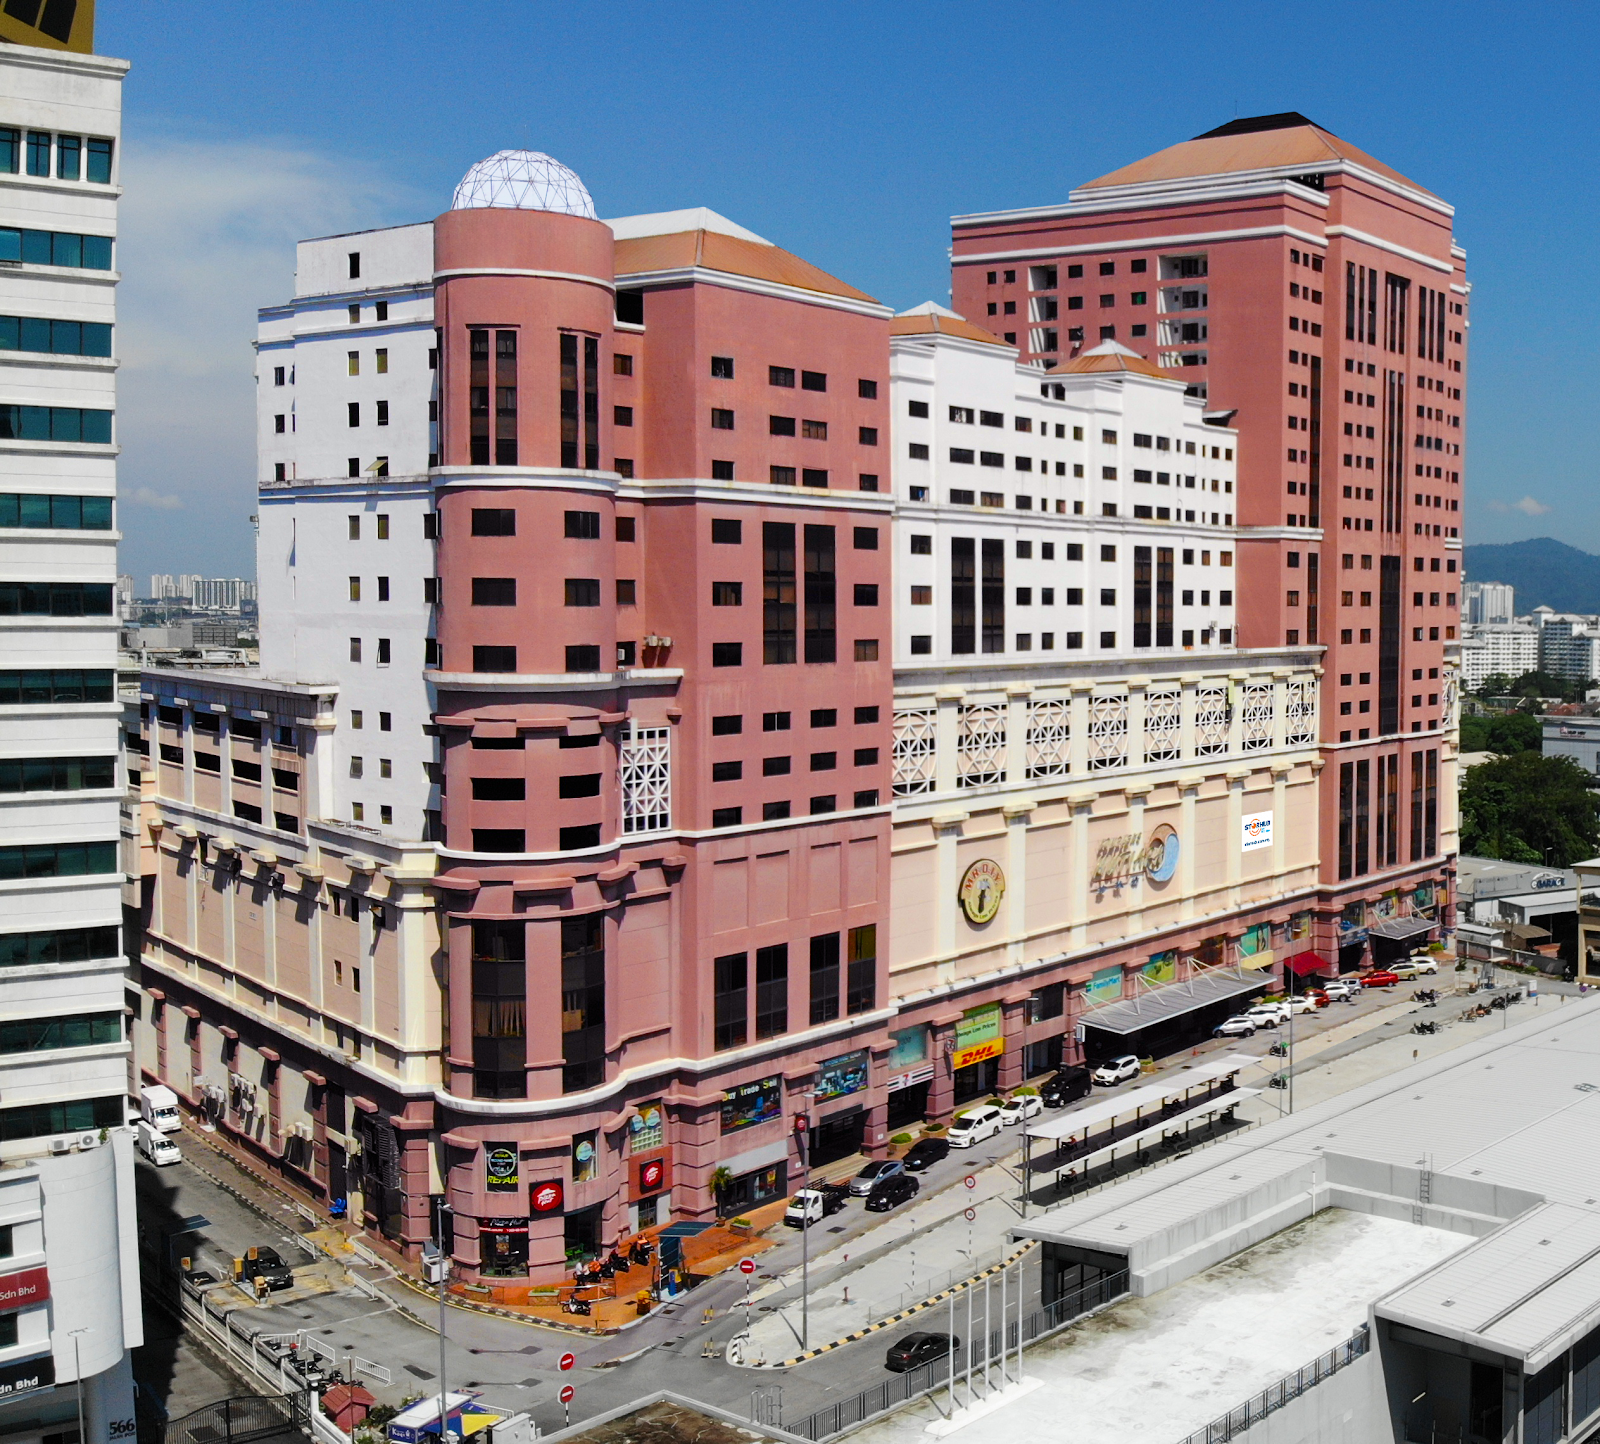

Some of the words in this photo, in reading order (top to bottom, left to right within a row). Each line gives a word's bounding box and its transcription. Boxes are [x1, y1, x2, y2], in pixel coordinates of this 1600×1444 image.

[960, 1045, 995, 1065] DHL
[18, 1284, 37, 1297] Bhd
[16, 1376, 39, 1390] Bhd
[109, 1417, 135, 1435] 566
